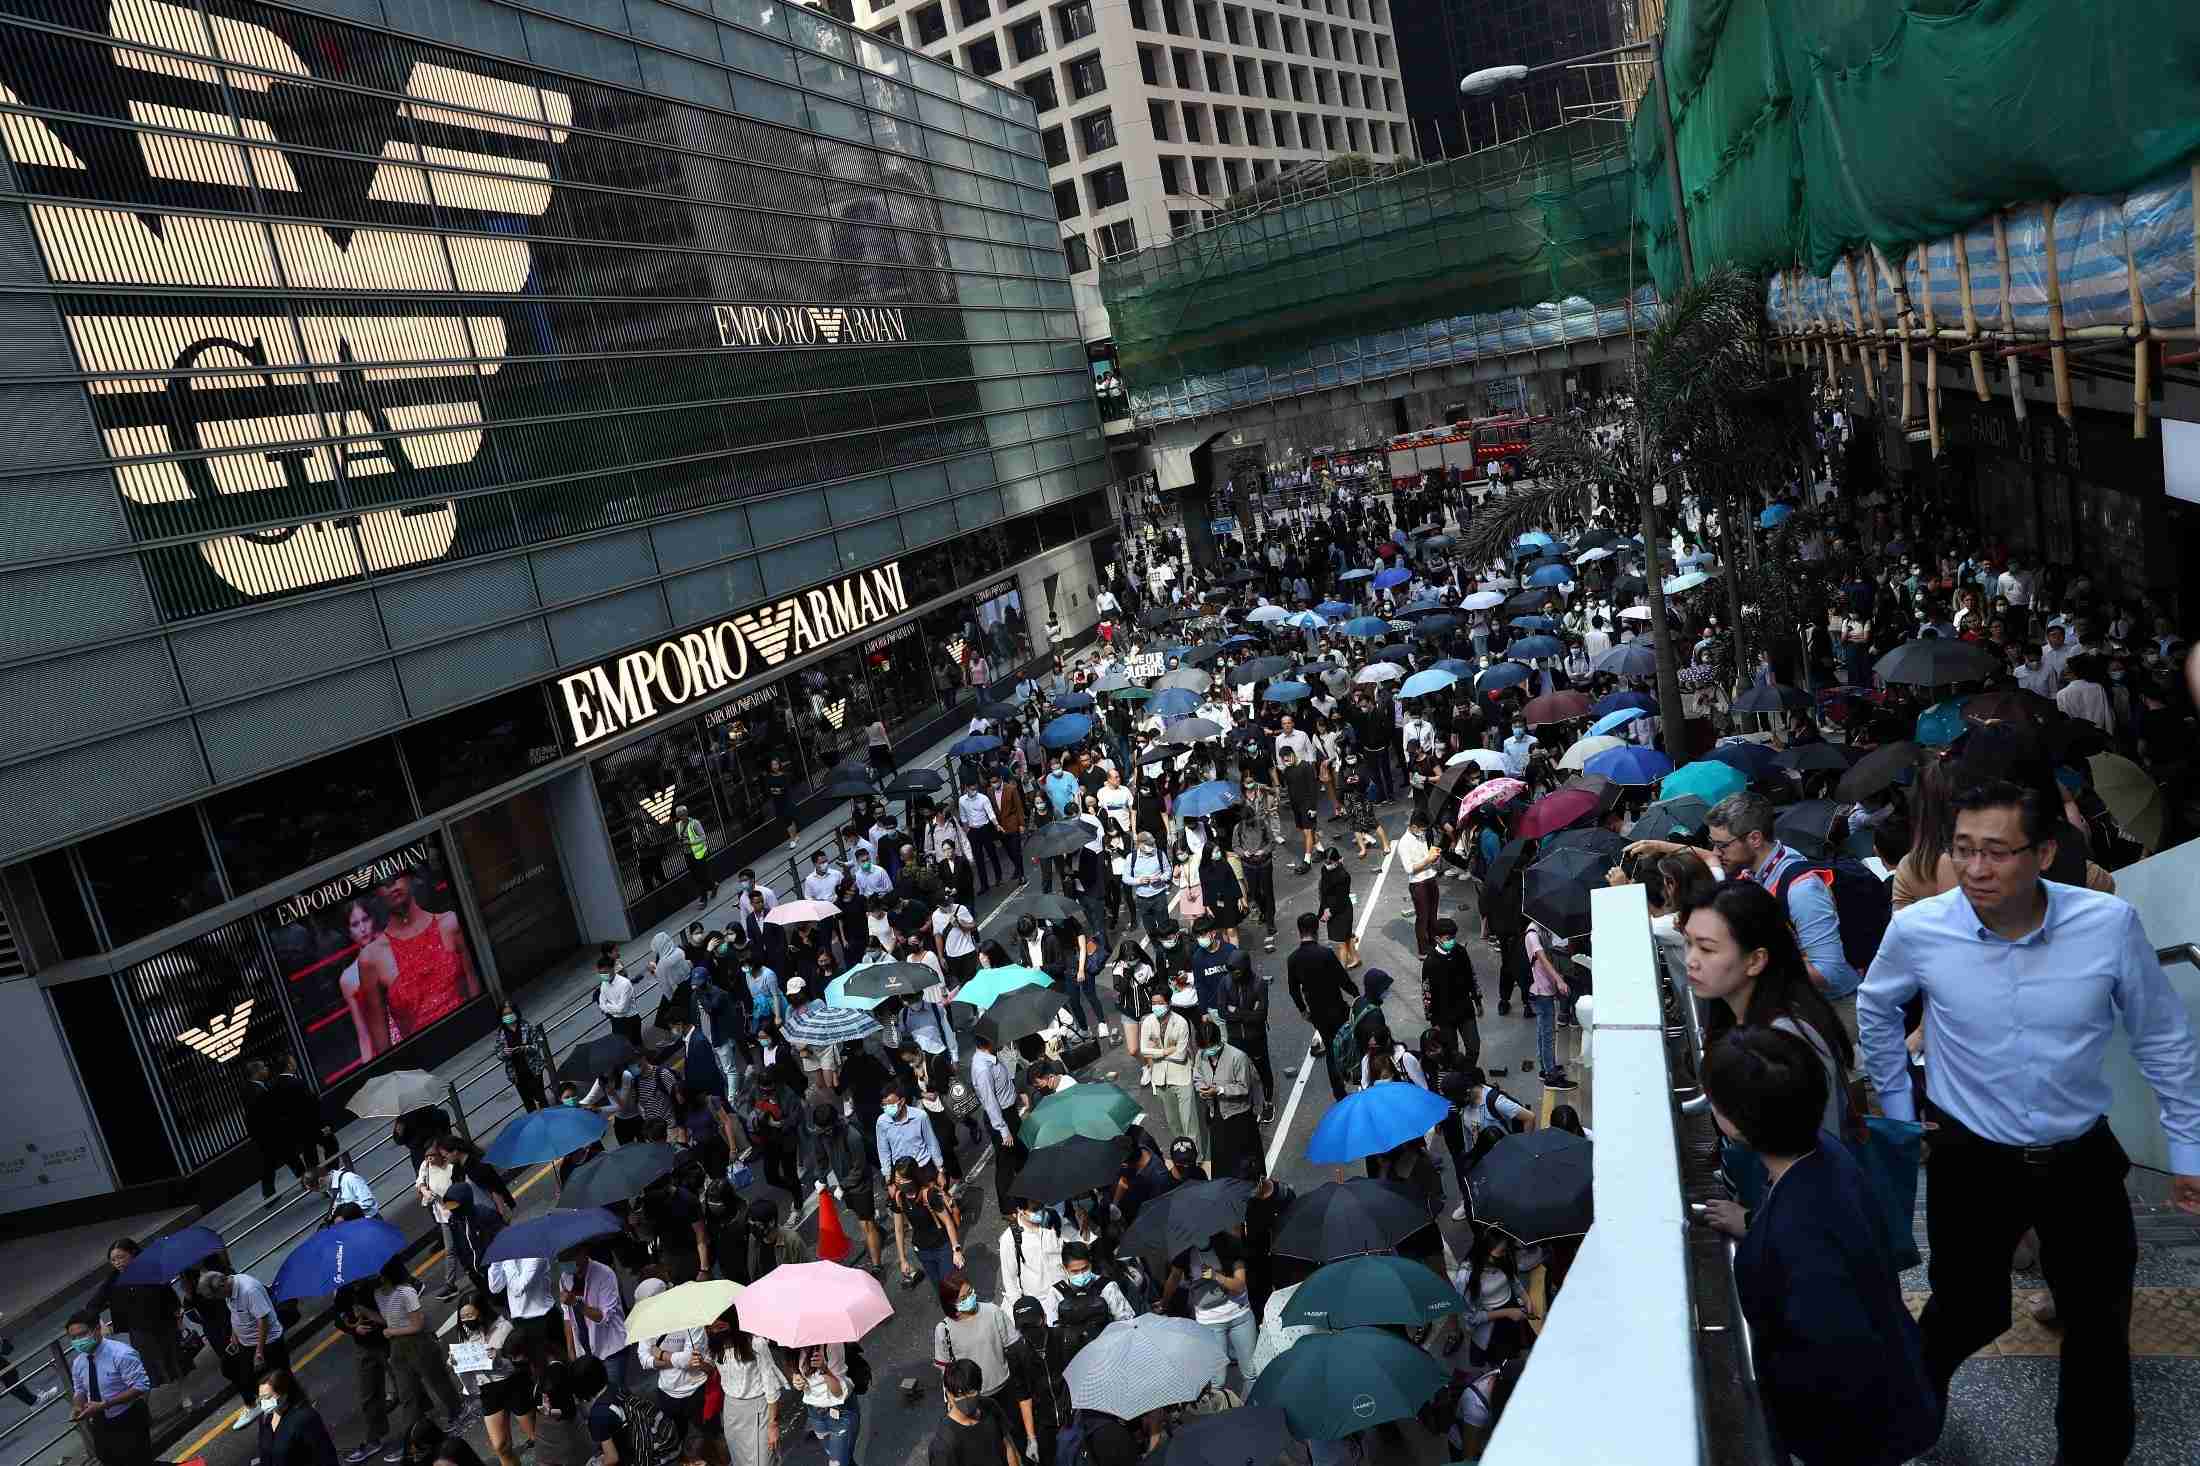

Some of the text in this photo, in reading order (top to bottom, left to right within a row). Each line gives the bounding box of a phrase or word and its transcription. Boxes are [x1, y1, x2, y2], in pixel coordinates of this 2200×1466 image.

[712, 305, 908, 346] EMPORIO ARMANI
[557, 562, 909, 748] EMPORIO ARMANI
[1146, 651, 1165, 665] OUR
[704, 703, 742, 728] EMPORIO
[275, 842, 428, 927] EMPORIO ARMANI
